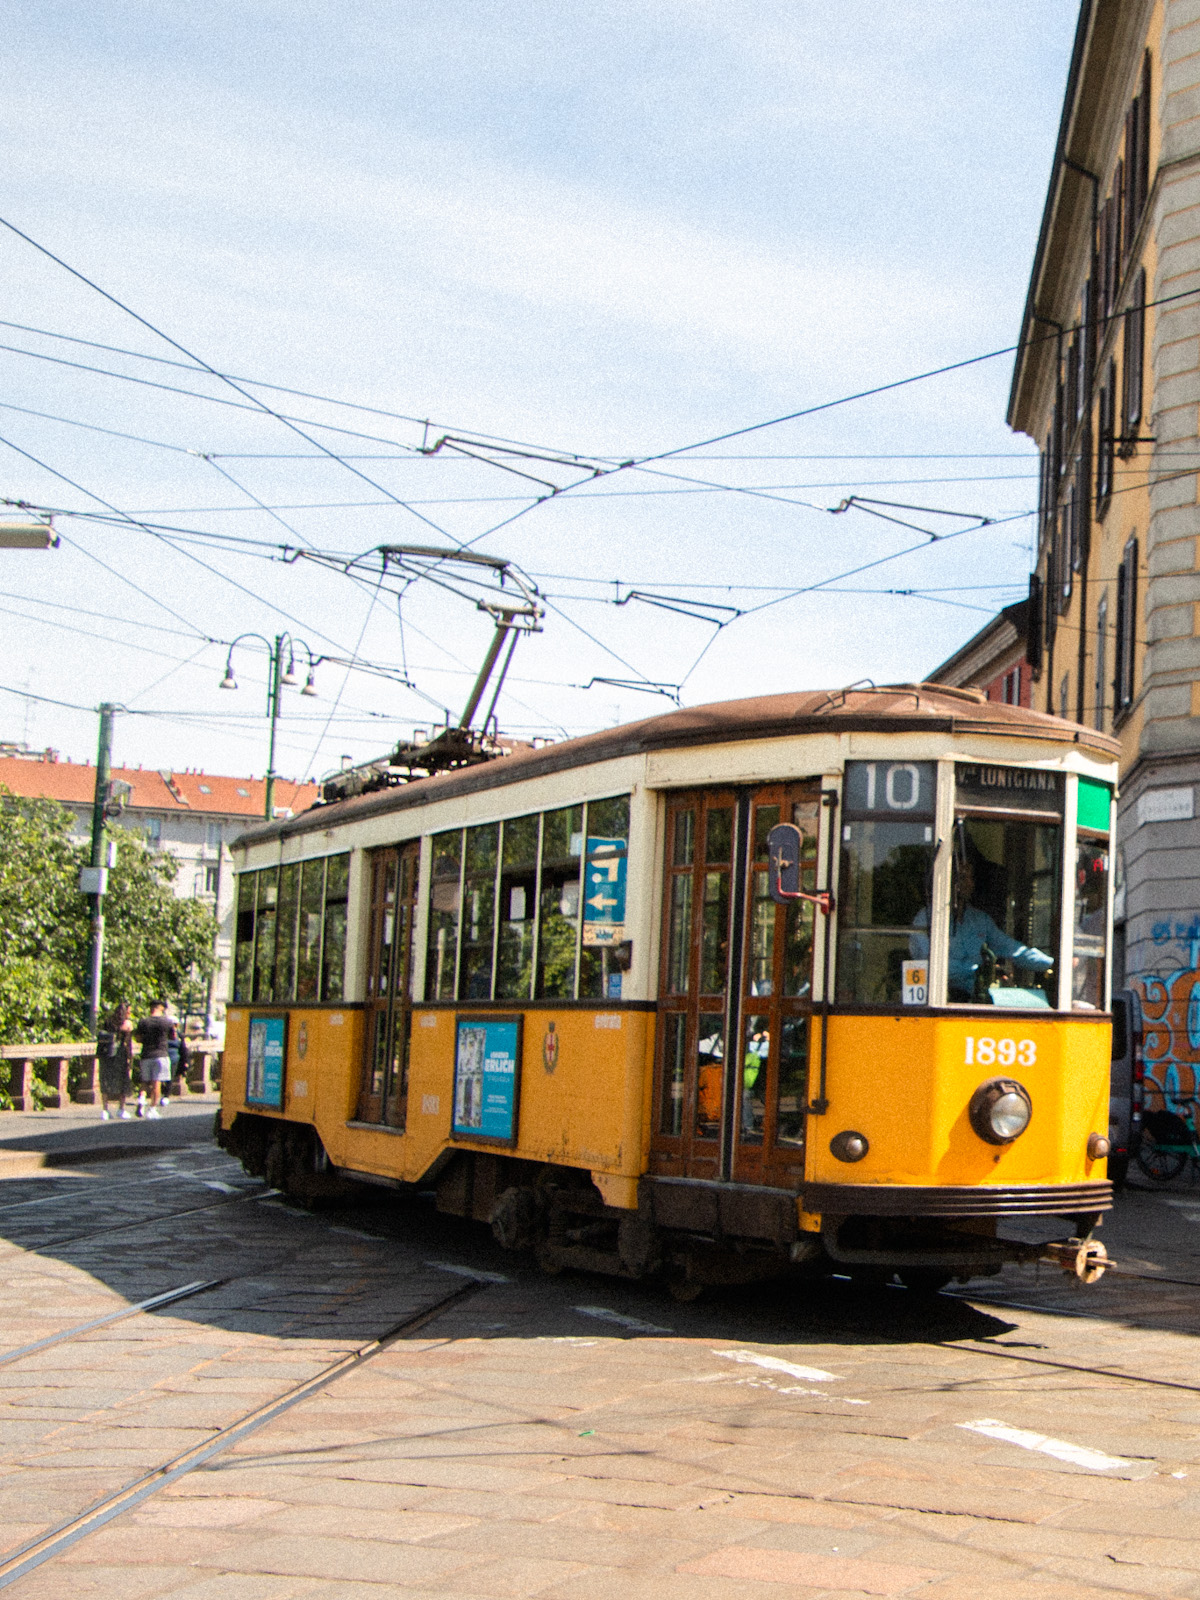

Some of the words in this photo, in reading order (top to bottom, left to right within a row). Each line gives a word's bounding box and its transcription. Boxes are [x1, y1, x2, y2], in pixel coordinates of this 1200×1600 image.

[866, 763, 921, 810] 10
[980, 768, 1056, 791] LUNIGIANA
[911, 969, 920, 984] 6
[908, 987, 924, 1002] 10
[964, 1037, 1037, 1067] 1893
[484, 1059, 515, 1074] ERLICH
